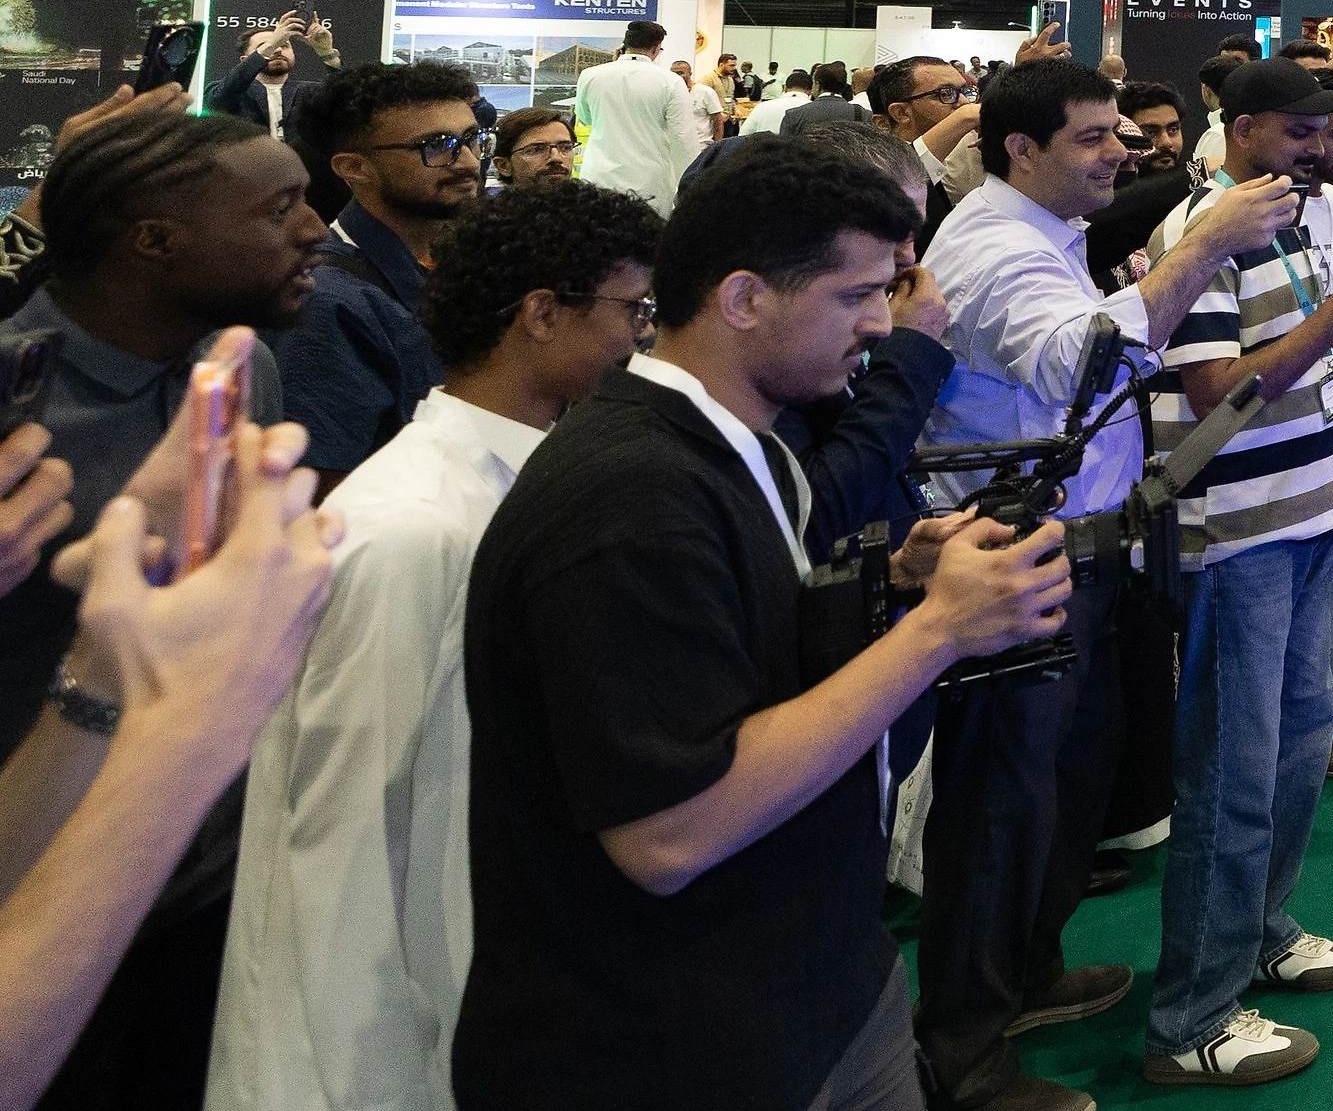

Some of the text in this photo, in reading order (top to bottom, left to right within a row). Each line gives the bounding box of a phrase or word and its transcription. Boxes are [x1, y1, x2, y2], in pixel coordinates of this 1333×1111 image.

[585, 7, 647, 15] STRUCTURES
[1127, 8, 1166, 21] Turning
[1197, 10, 1218, 20] Into
[1218, 10, 1252, 21] Action
[217, 16, 240, 27] 55
[22, 70, 47, 78] Saudi
[22, 76, 77, 85] National Day
